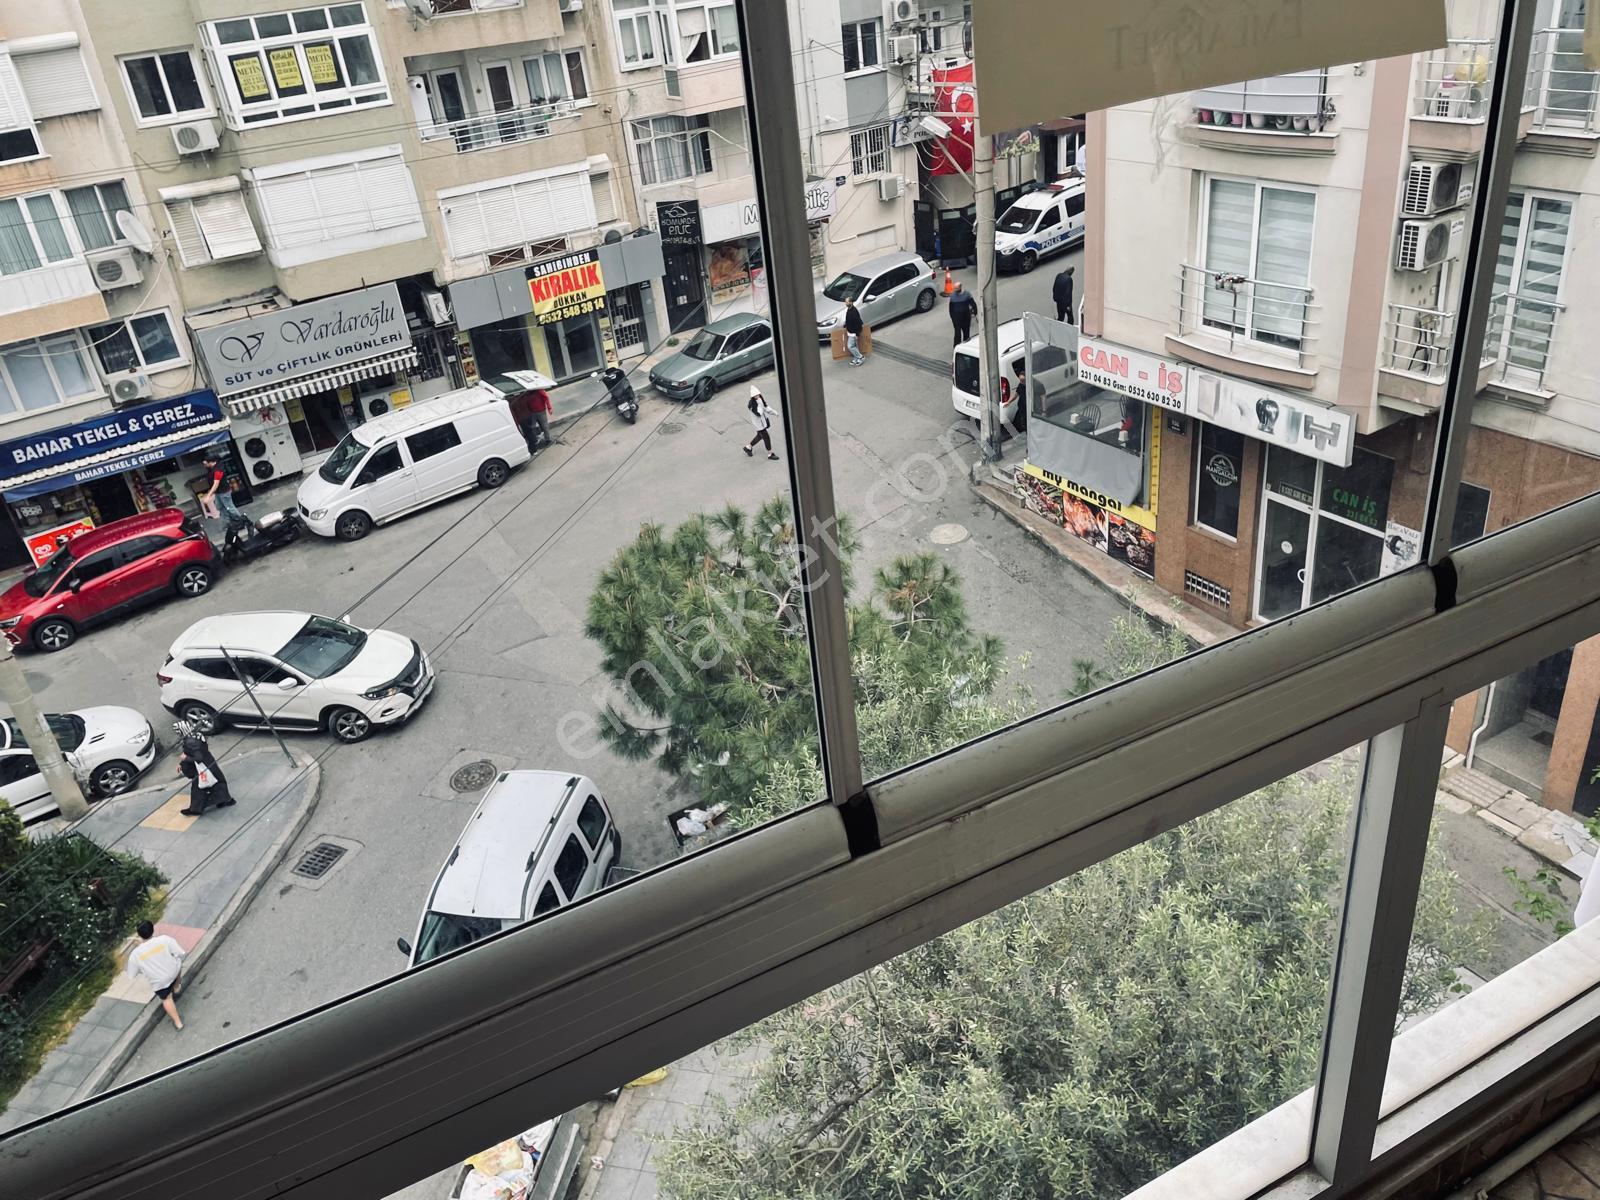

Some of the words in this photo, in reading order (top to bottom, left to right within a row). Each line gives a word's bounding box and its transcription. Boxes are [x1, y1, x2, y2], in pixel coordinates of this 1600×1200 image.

[280, 300, 395, 344] Vardaroğlu
[563, 306, 581, 319] 548
[581, 301, 594, 313] 38
[594, 297, 605, 310] 14
[225, 370, 253, 386] SÜT
[257, 368, 273, 378] ve
[277, 345, 332, 374] ÇİFTLİK
[335, 332, 404, 358] ÜRÜNLERİ
[1080, 345, 1129, 379] CAN
[1158, 362, 1183, 399] İŞ
[1080, 370, 1092, 380] 231
[1093, 374, 1102, 383] 04
[1103, 377, 1111, 387] 83
[1112, 381, 1127, 392] Gsm:
[1128, 385, 1145, 398] 0532
[1147, 390, 1160, 403] 630
[1161, 395, 1171, 406] 82
[1172, 398, 1182, 409] 30
[12, 437, 73, 464] BAHAR
[72, 422, 128, 448] TEKEL
[128, 418, 141, 433] &
[142, 403, 196, 431] ÇEREZ
[74, 467, 105, 482] BAHAR
[103, 460, 131, 475] TEKEL
[131, 457, 139, 467] &
[138, 450, 166, 465] ÇEREZ
[1042, 468, 1062, 484] my
[1332, 488, 1359, 508] CAN
